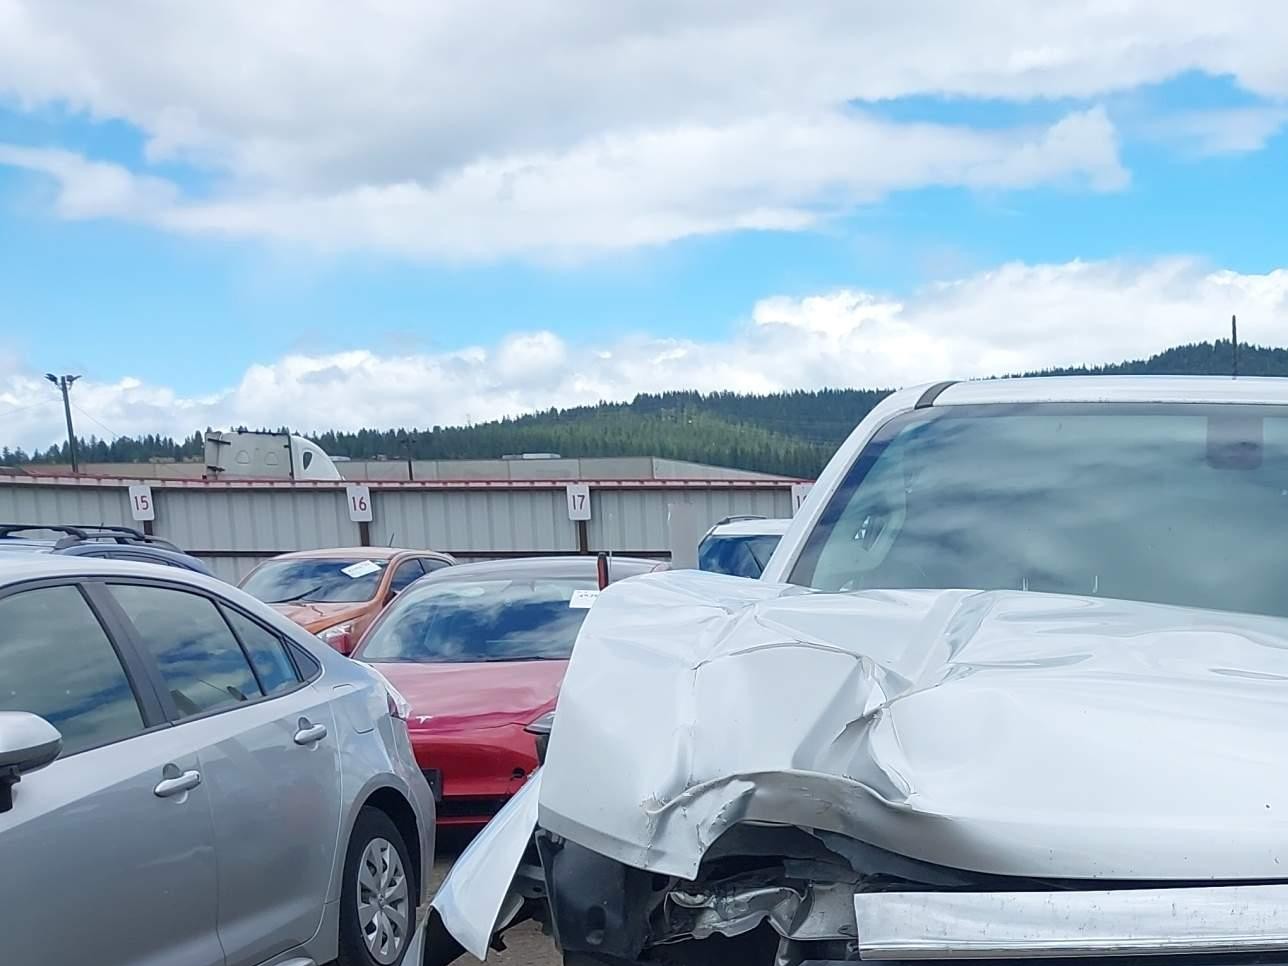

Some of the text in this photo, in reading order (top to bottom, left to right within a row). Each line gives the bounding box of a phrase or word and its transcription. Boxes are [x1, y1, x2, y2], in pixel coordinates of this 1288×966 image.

[133, 495, 150, 511] 15
[351, 495, 368, 512] 16
[571, 494, 586, 511] 17
